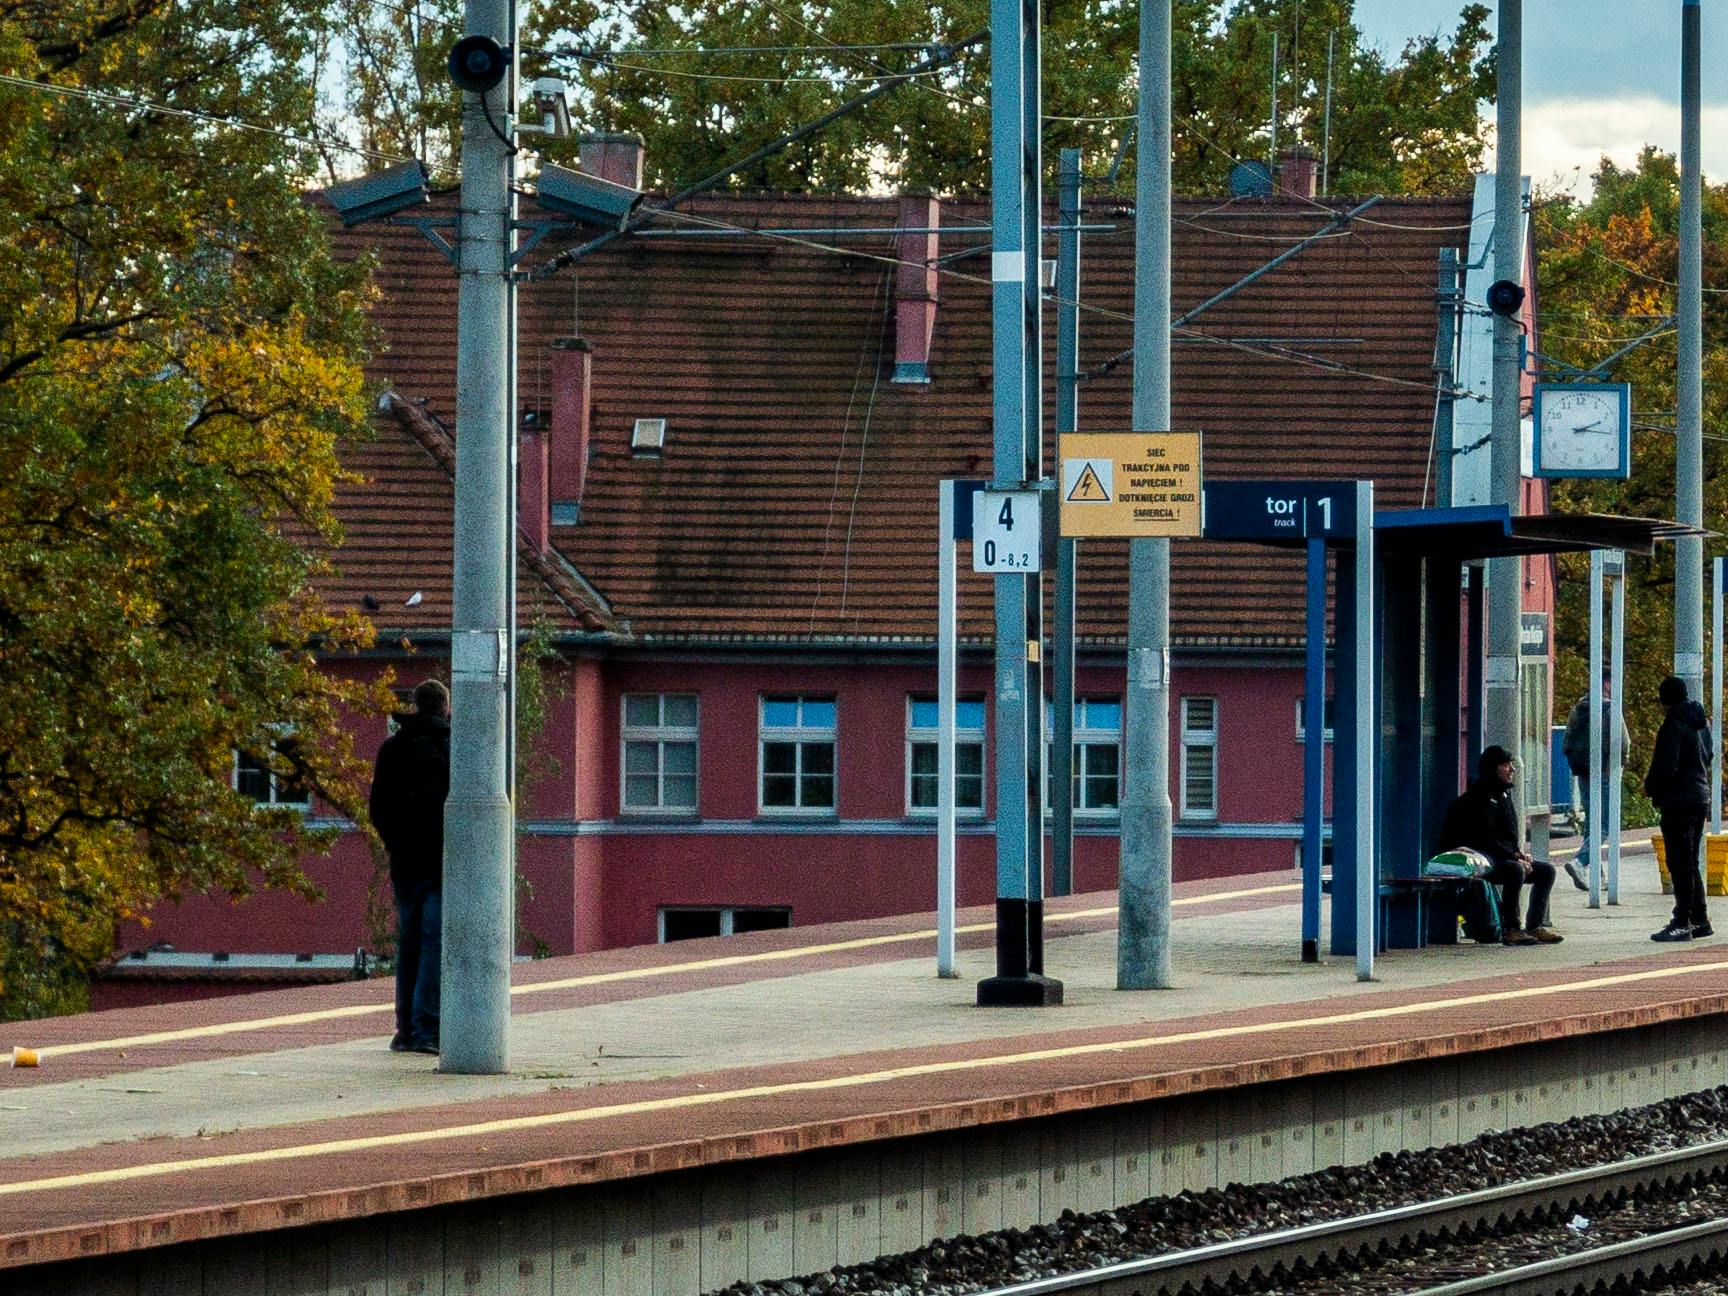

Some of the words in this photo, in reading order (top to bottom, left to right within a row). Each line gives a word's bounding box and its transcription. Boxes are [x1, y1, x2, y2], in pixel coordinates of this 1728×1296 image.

[1122, 464, 1171, 472] TRAKCYJNA
[1173, 464, 1190, 472] POD
[999, 497, 1014, 531] 4
[1265, 497, 1297, 513] tor
[1317, 497, 1331, 529] 1
[1274, 517, 1296, 527] track
[985, 540, 995, 566] 0
